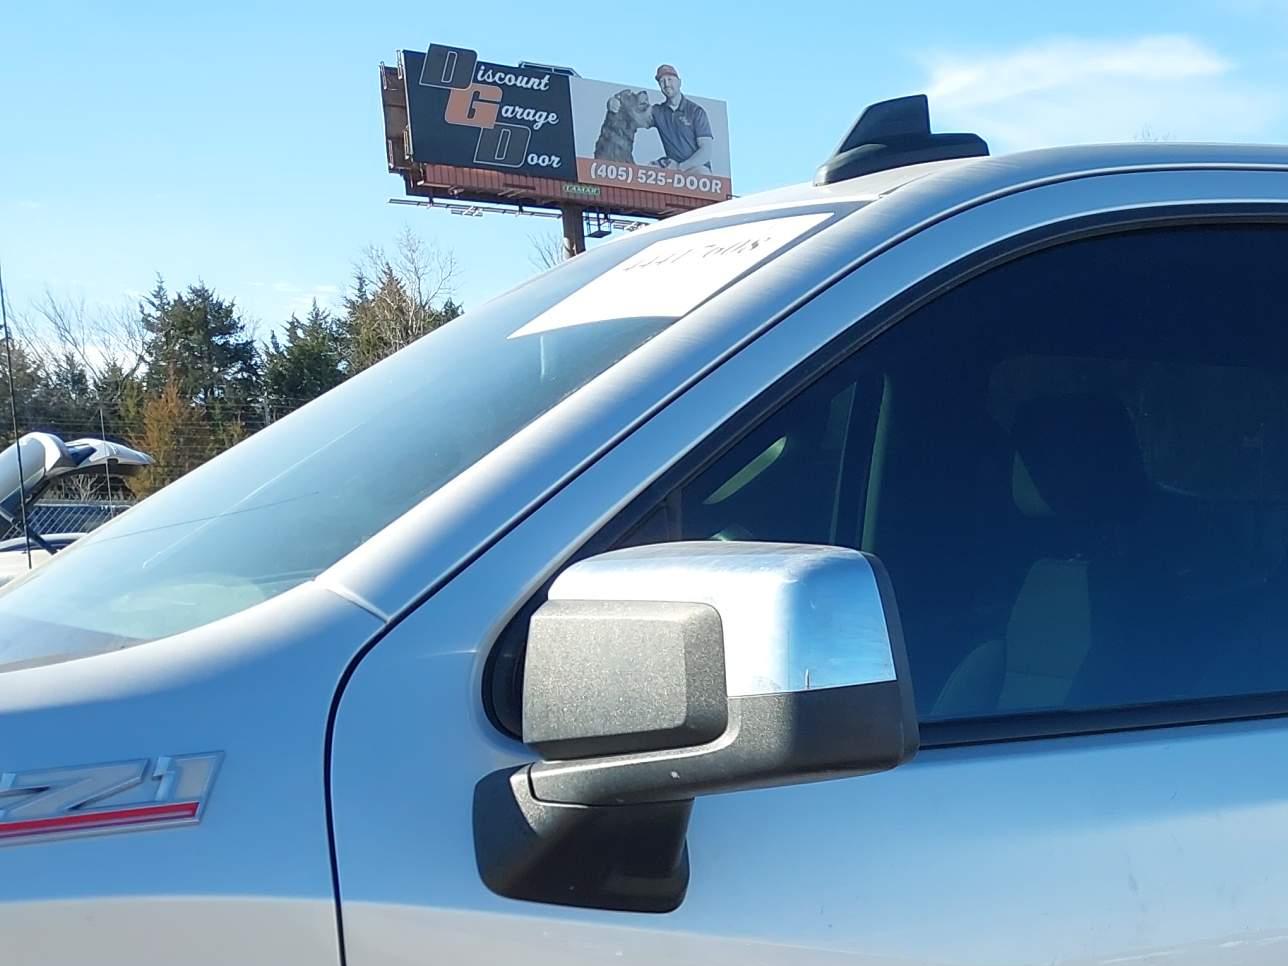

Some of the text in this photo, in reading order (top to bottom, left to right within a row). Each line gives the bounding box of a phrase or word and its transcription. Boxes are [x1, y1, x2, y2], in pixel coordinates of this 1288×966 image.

[420, 43, 551, 92] Discount
[445, 83, 559, 130] Garage
[473, 122, 562, 168] Door
[590, 163, 722, 194] (405) 525-DOOR
